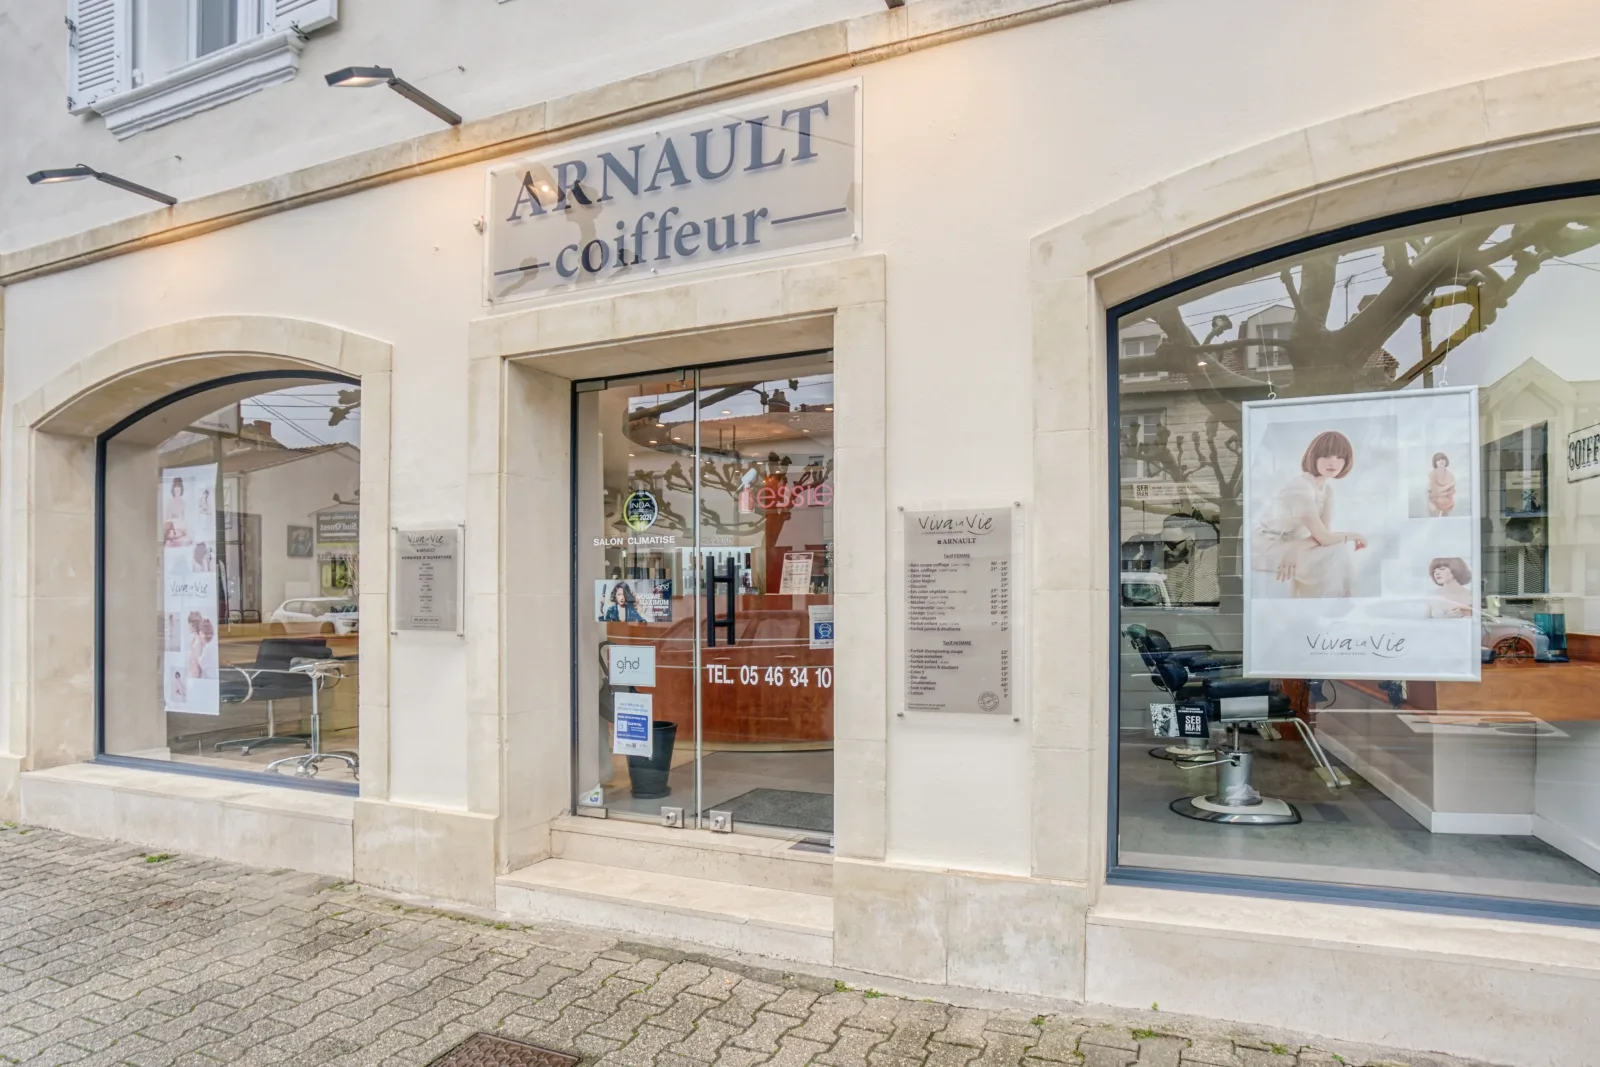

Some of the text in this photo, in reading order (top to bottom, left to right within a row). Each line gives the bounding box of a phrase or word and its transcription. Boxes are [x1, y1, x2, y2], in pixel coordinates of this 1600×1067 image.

[506, 100, 829, 222] ARNAULT
[556, 206, 769, 278] coiffeur
[757, 484, 833, 509] essie
[919, 514, 953, 530] Viva
[966, 513, 993, 530] Vie
[593, 536, 676, 546] SALON CLIMATISE
[1306, 632, 1352, 650] Viva
[1370, 632, 1406, 652] Vie
[616, 656, 640, 674] ghd
[706, 664, 832, 688] TEL. 05 46 34 10
[1185, 716, 1201, 724] SEB
[1185, 724, 1201, 732] MAN
